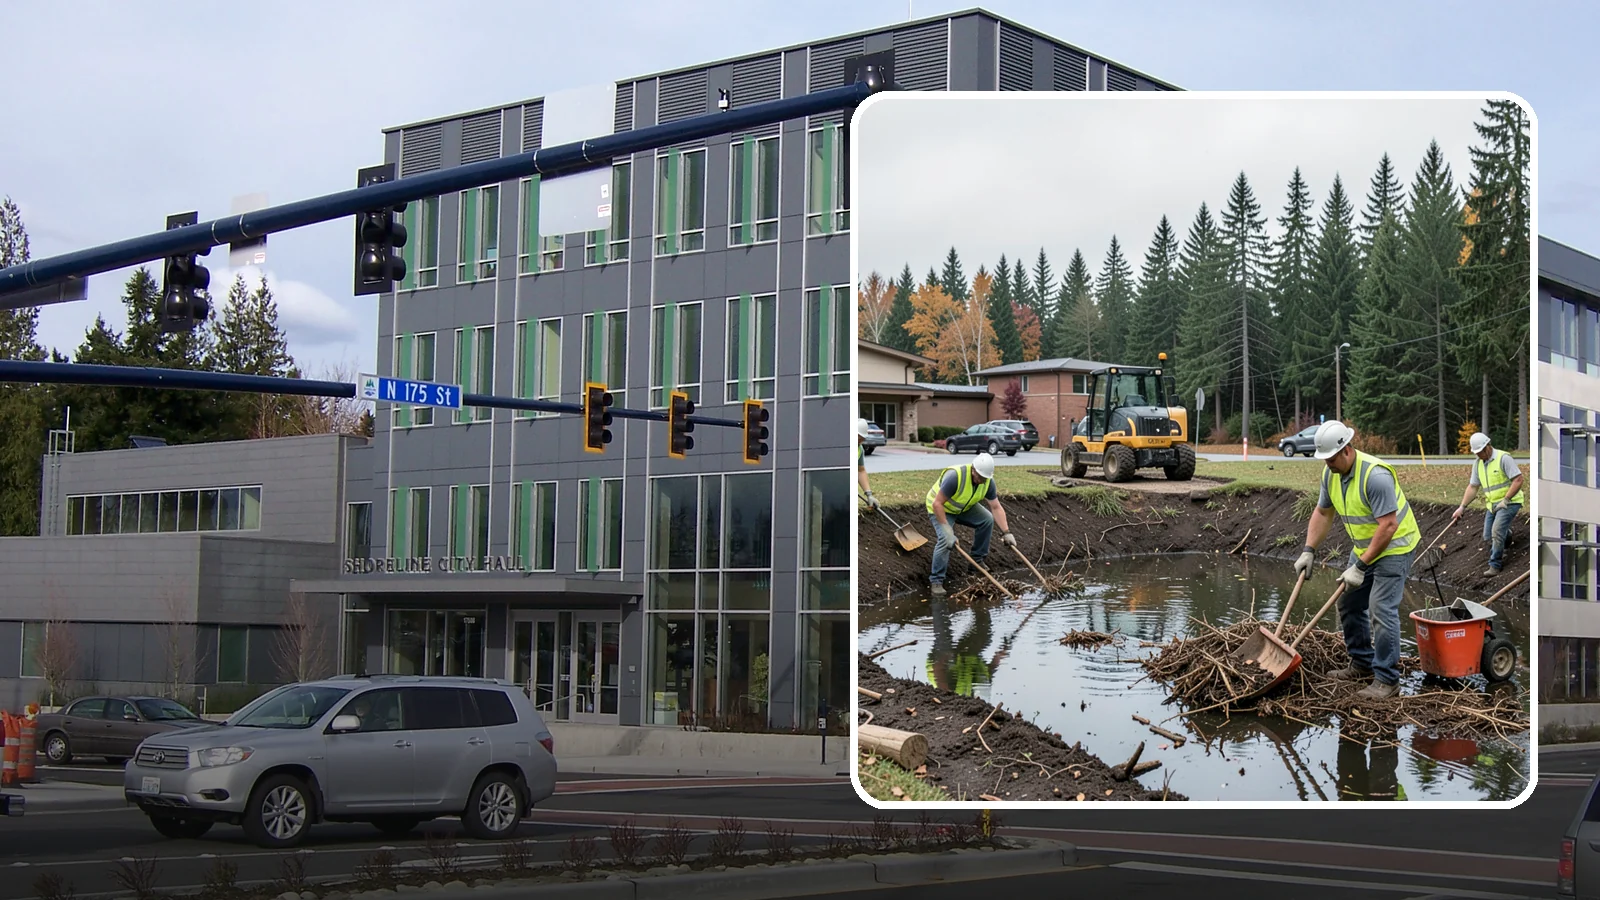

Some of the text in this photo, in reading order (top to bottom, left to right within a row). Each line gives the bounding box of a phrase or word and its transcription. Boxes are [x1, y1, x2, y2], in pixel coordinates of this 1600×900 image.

[387, 380, 451, 406] N 175 St
[345, 556, 525, 574] SHORELINE CITY HALL
